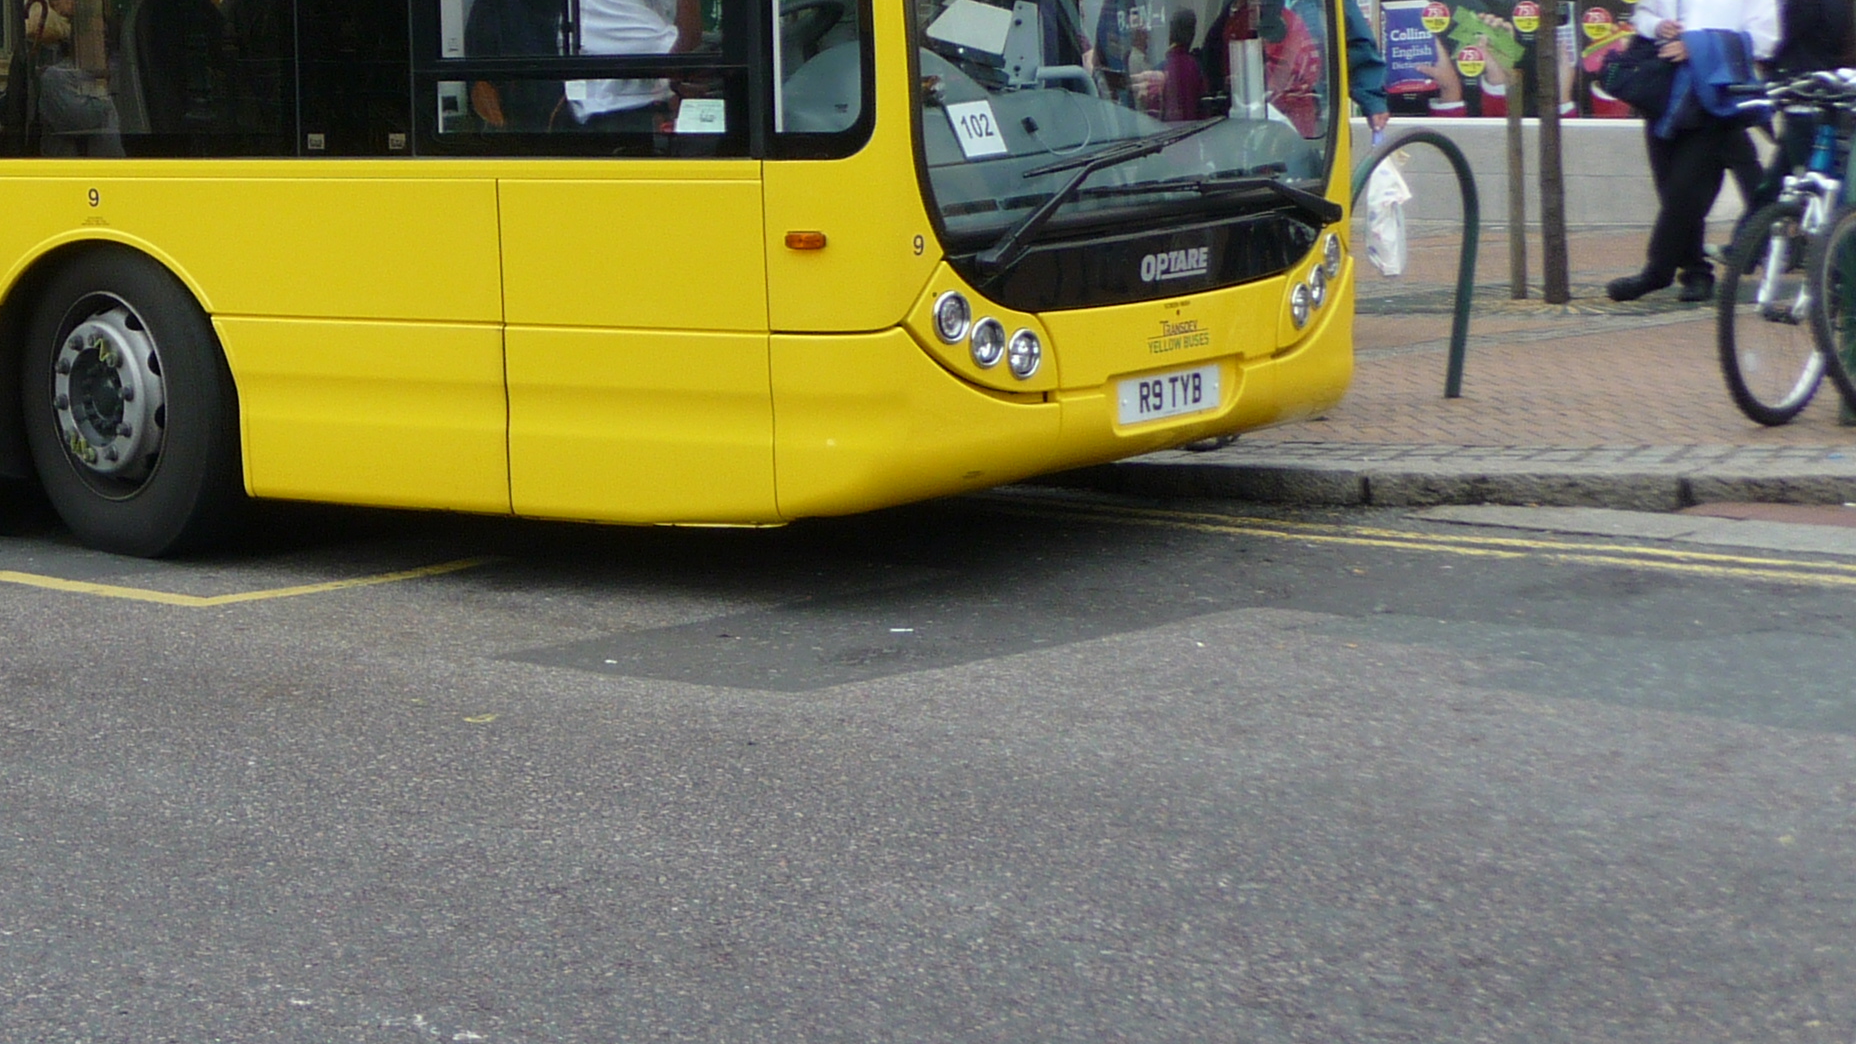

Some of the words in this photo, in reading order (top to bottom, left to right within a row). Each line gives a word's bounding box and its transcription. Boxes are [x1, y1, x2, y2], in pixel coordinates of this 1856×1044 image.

[1390, 28, 1432, 42] Collins
[1392, 46, 1433, 60] English
[960, 113, 994, 139] 102
[87, 187, 100, 208] 9
[912, 235, 925, 256] 9
[1140, 246, 1209, 281] OPTARE
[1159, 319, 1198, 336] TRANSDEV
[1148, 337, 1182, 354] YELLOW
[1183, 332, 1210, 349] BUSES
[1139, 379, 1163, 414] R9
[1169, 372, 1202, 408] TYB
